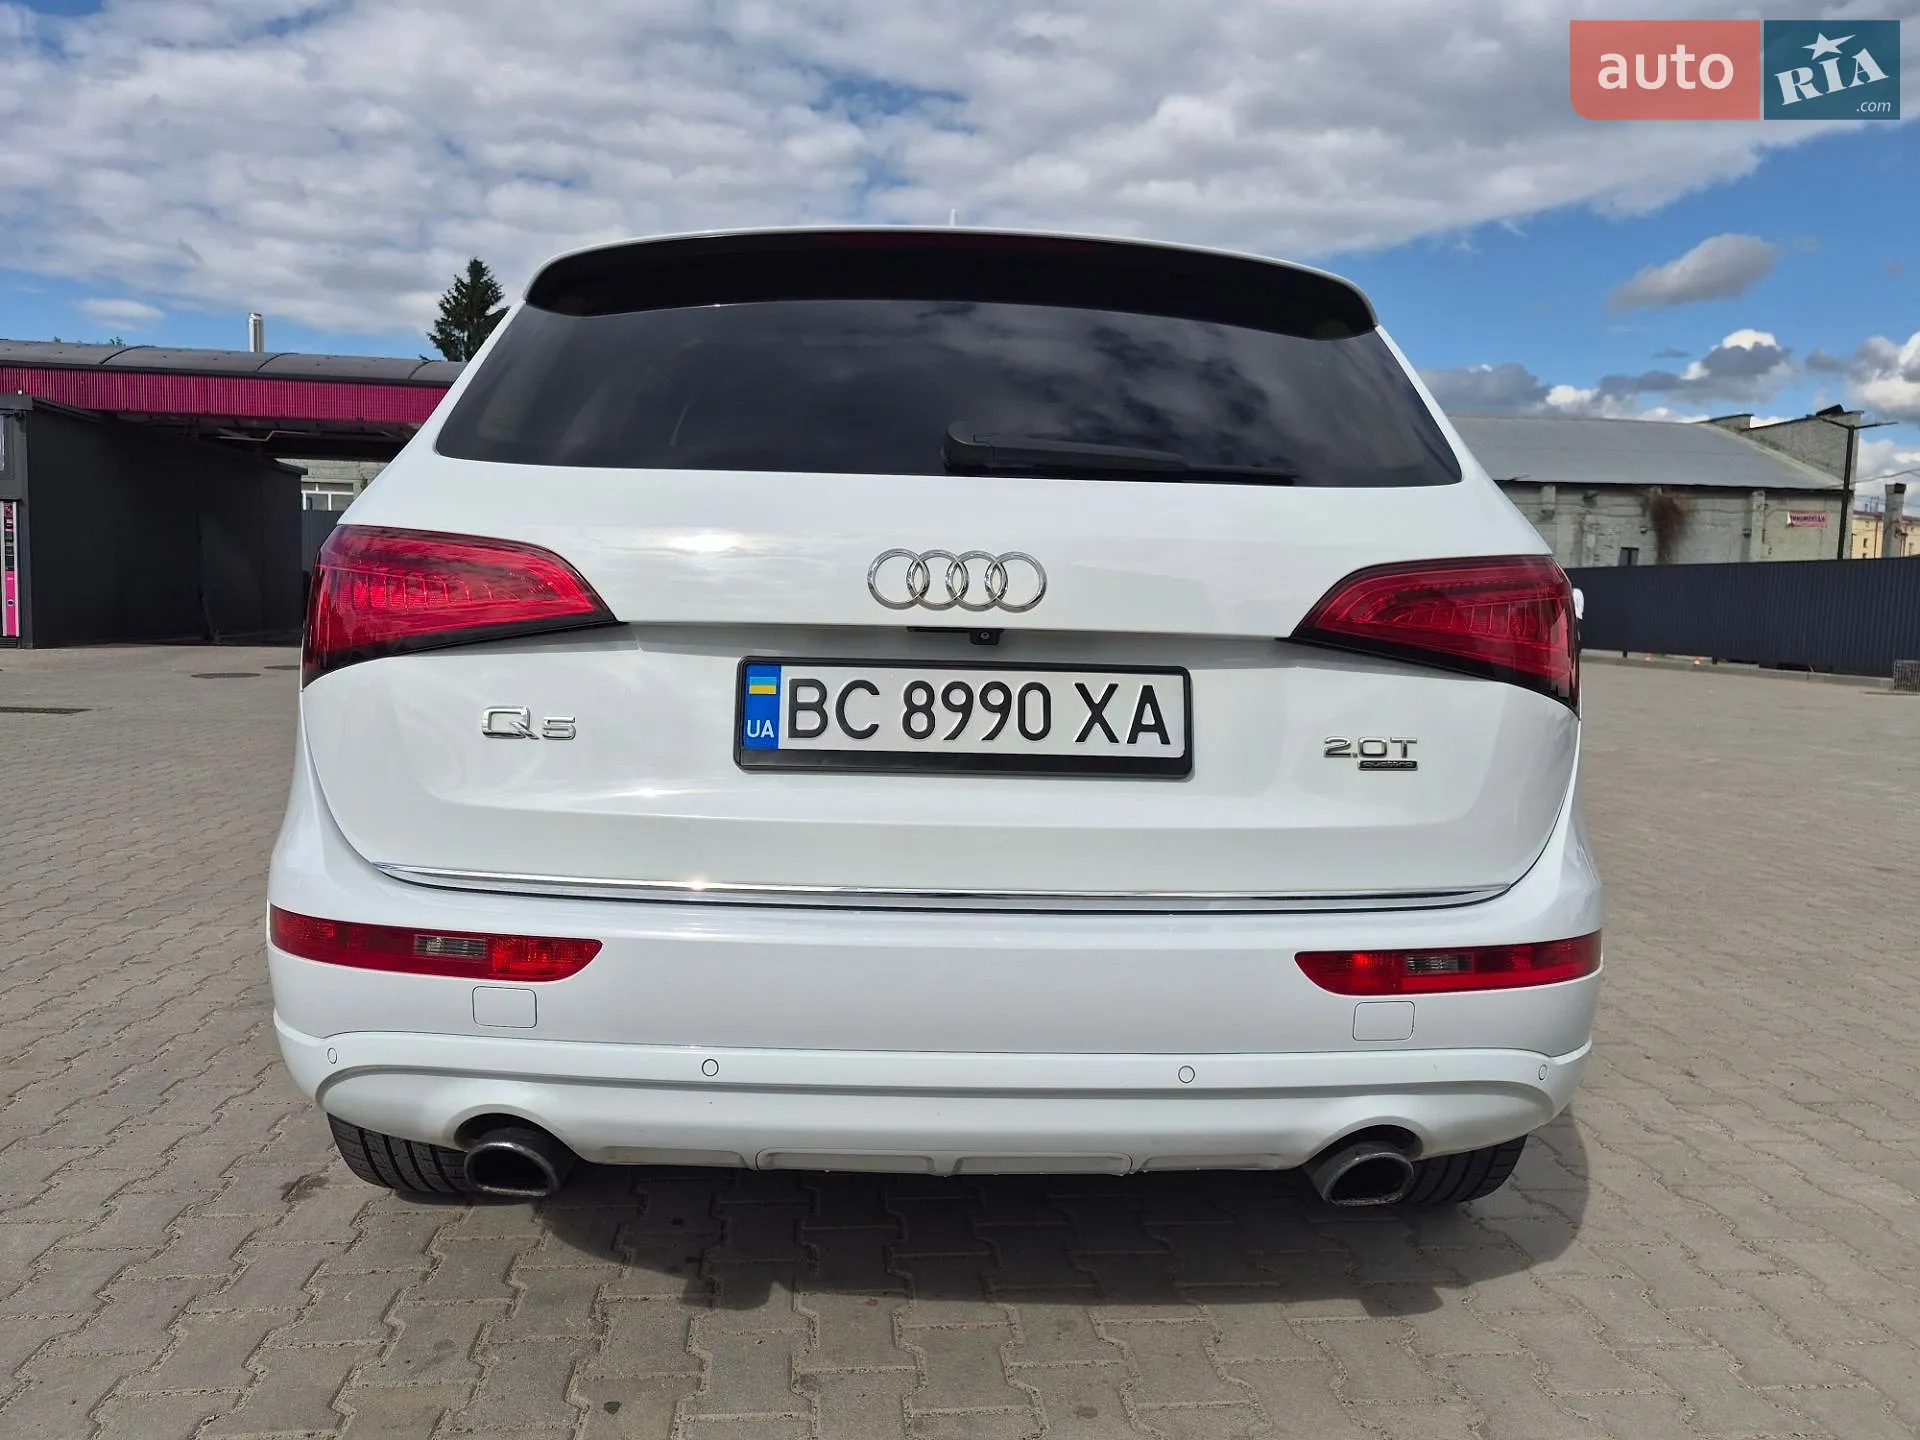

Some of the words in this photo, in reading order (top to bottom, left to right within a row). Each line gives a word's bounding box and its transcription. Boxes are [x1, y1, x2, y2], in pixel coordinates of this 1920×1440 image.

[482, 706, 576, 740] Q5
[787, 678, 880, 740] BC
[902, 680, 1052, 742] 8990
[1074, 682, 1171, 745] XA
[746, 719, 774, 739] UA
[1324, 736, 1417, 758] 2.0T
